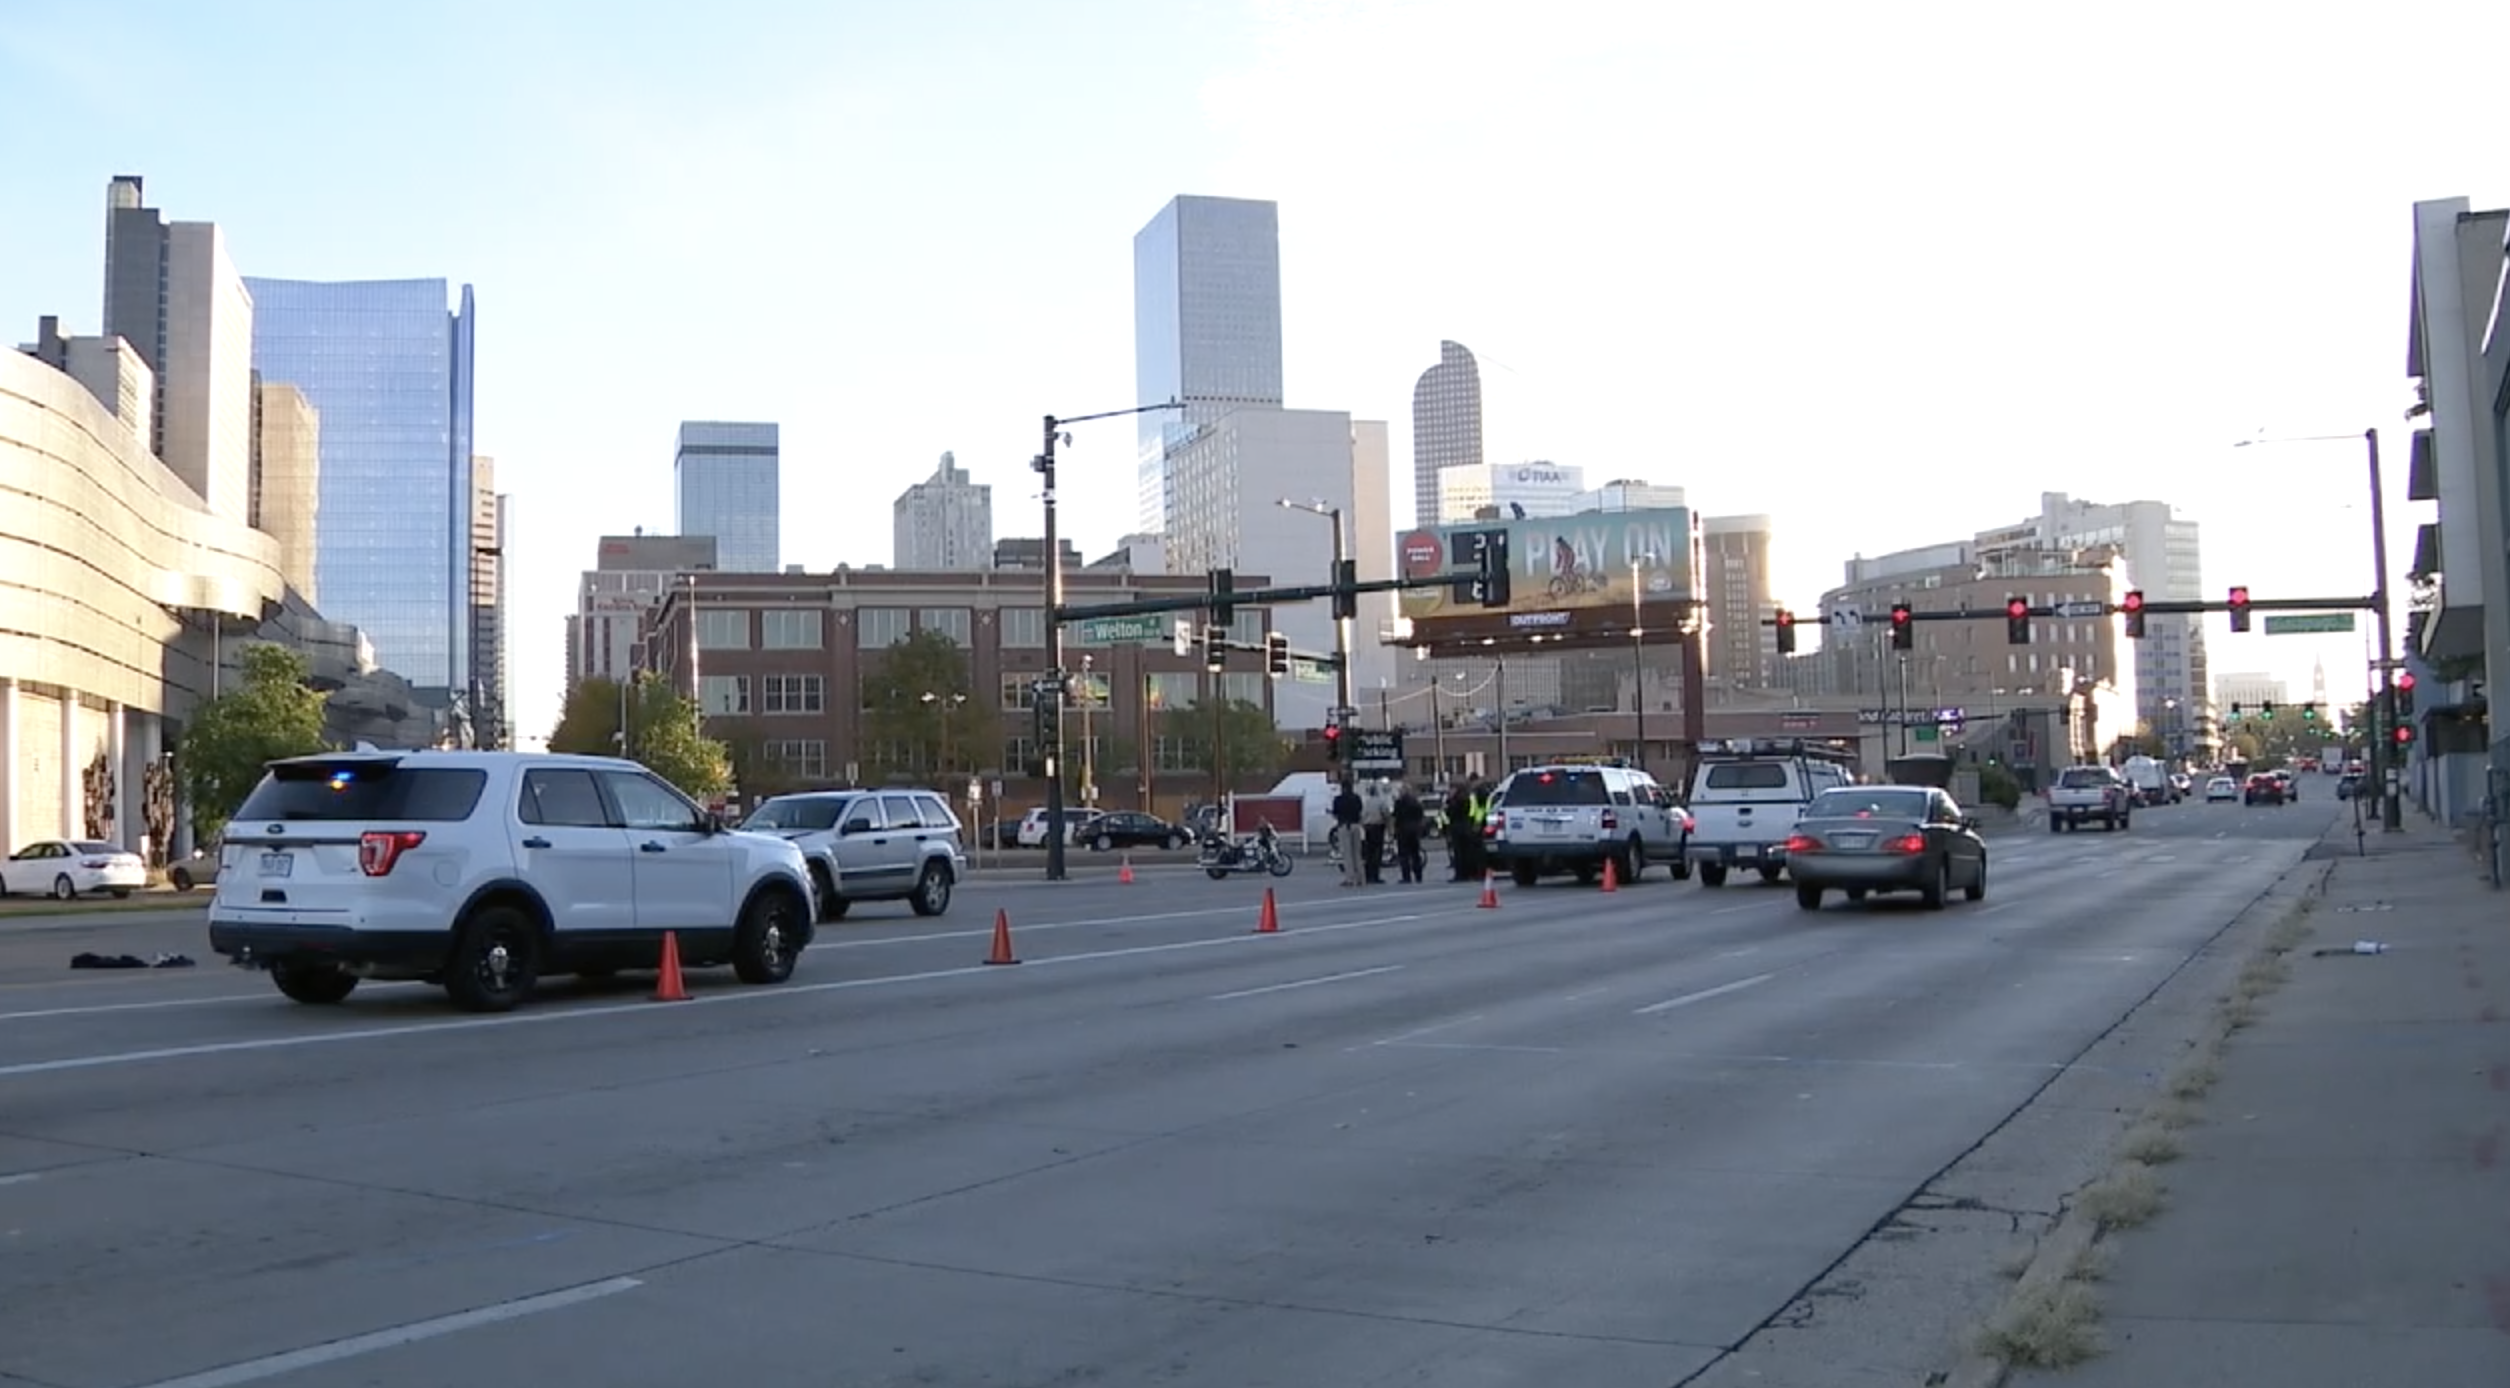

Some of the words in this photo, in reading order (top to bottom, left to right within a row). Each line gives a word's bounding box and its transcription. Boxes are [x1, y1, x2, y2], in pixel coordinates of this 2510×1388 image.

[1533, 470, 1561, 483] TIAA
[1525, 526, 1610, 577] PLAY
[1624, 521, 1671, 568] ON
[1095, 620, 1143, 640] Welton
